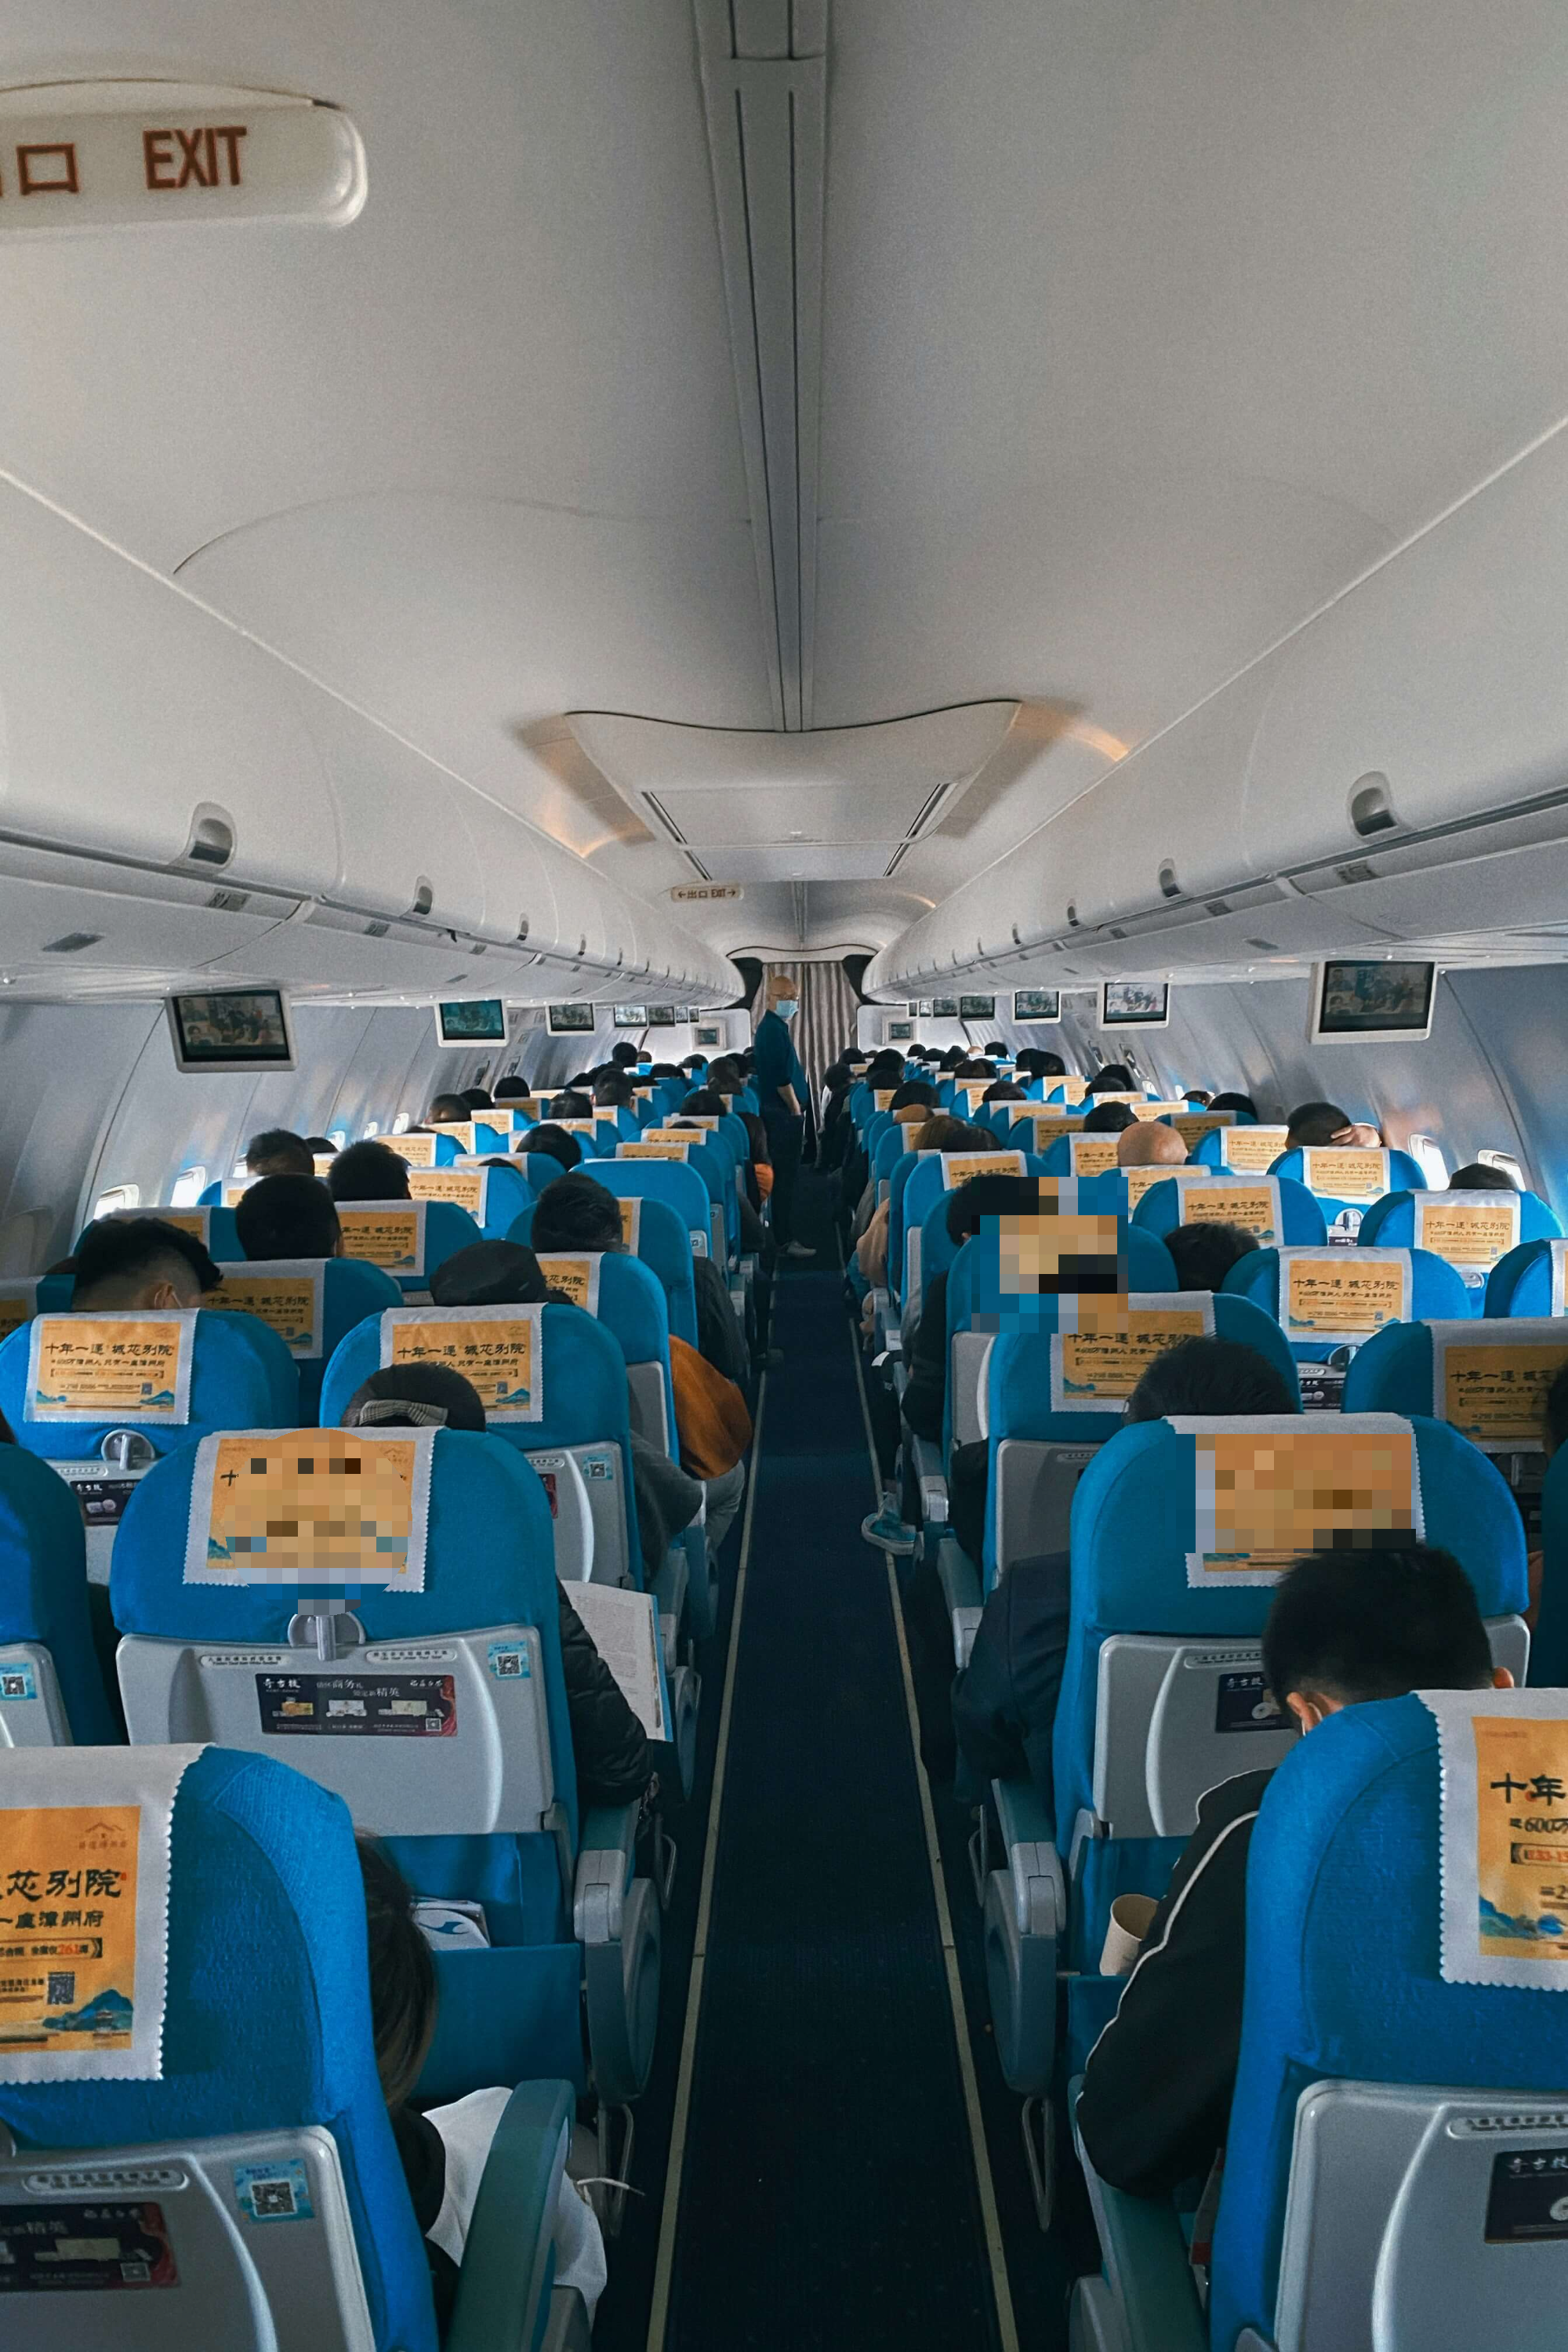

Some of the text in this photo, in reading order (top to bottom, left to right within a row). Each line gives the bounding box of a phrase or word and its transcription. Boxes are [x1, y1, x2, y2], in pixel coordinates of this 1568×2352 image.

[0, 143, 79, 197] 口
[143, 125, 247, 191] EXIT
[687, 890, 707, 899] 出口
[711, 888, 725, 898] EXIT
[0, 1868, 122, 1903] 芯别院
